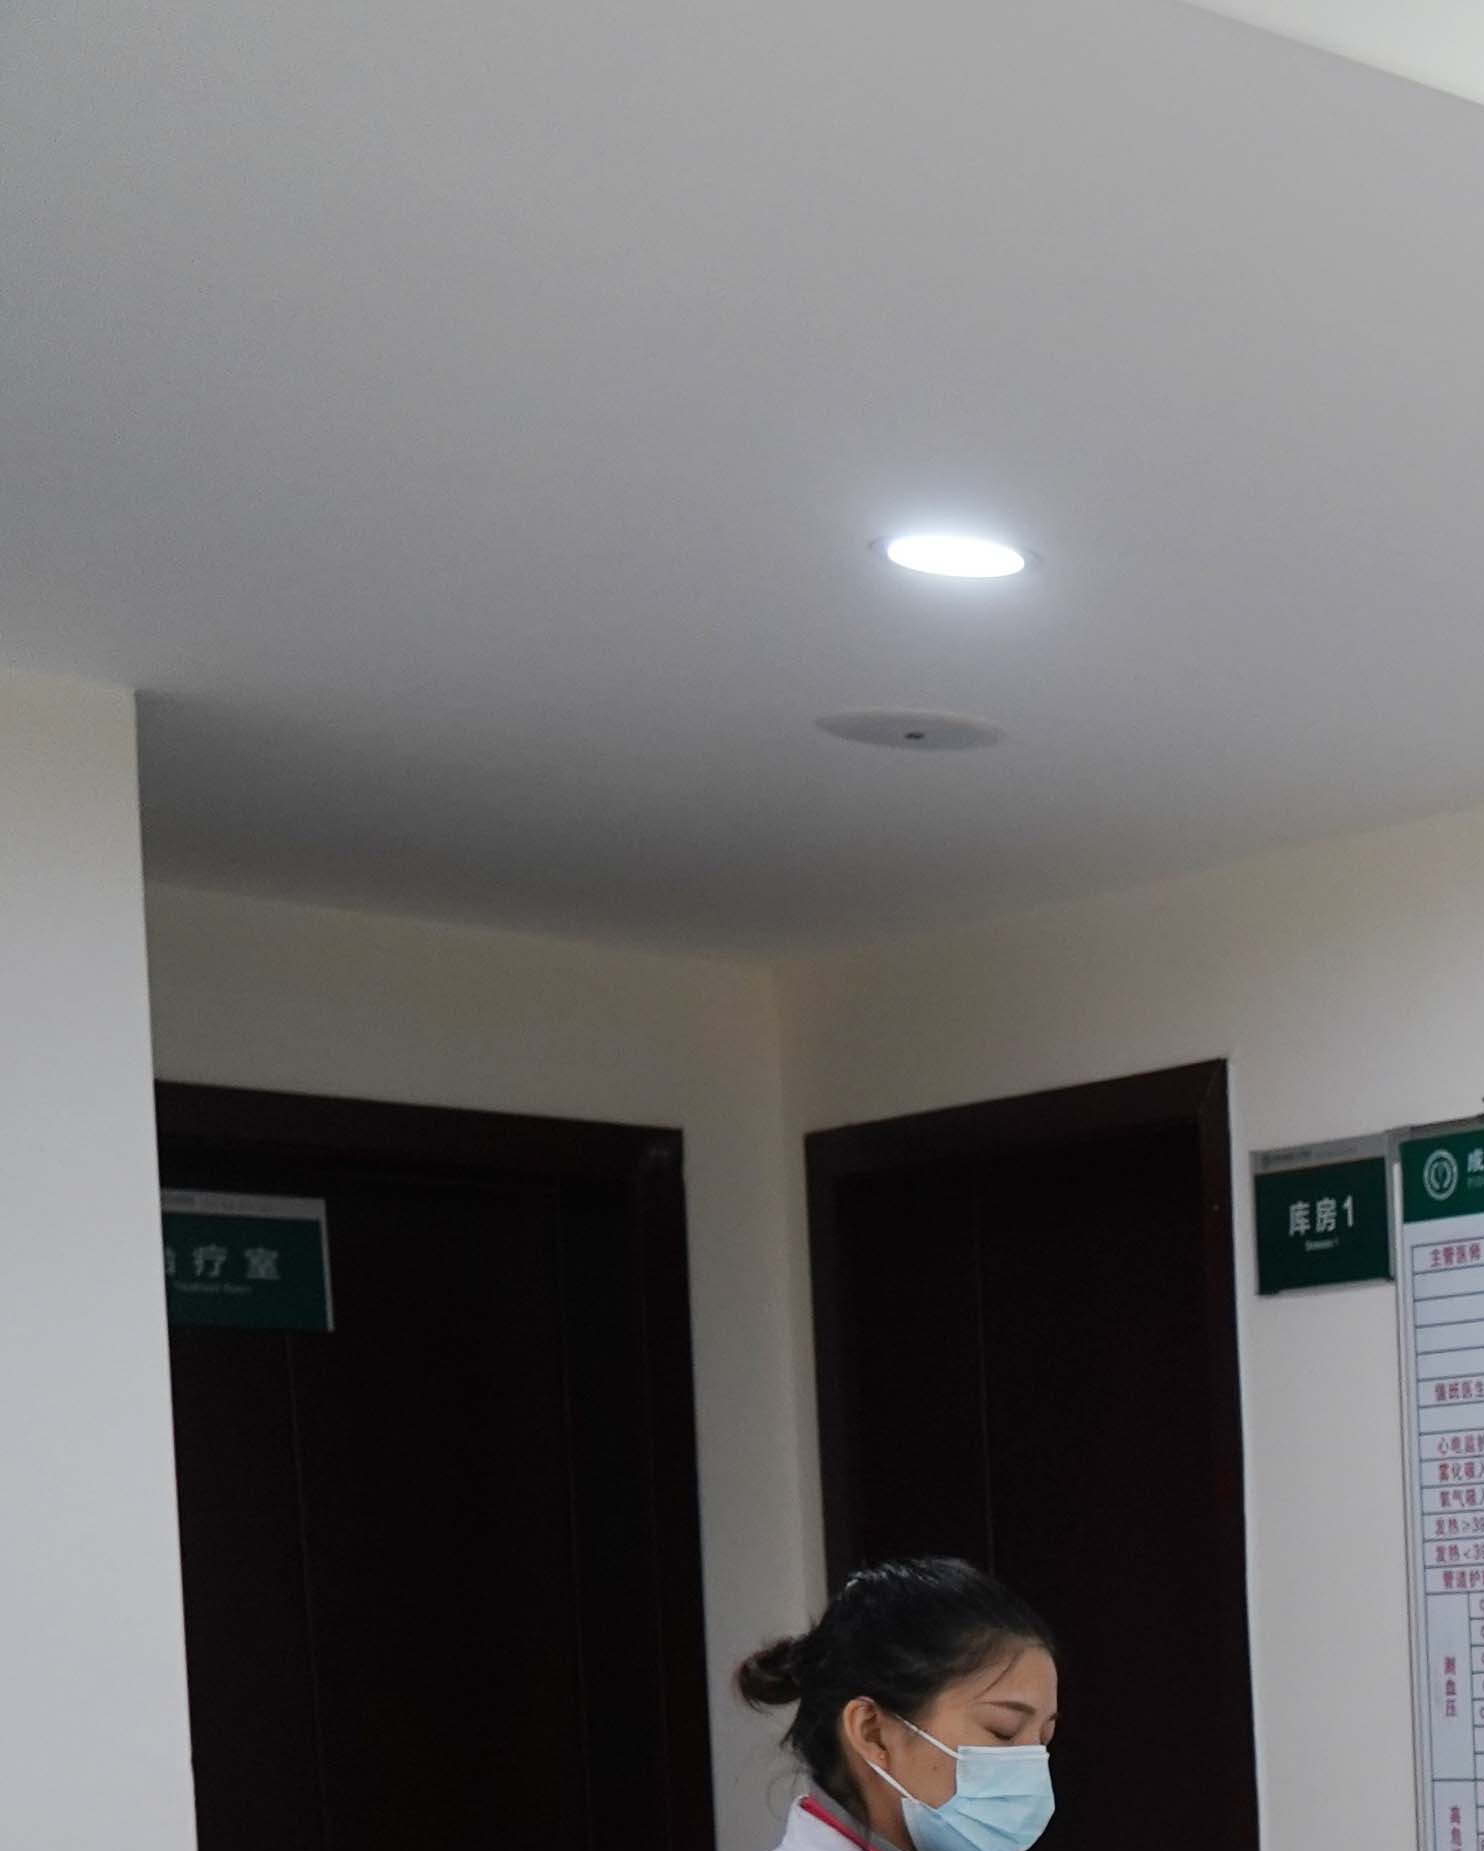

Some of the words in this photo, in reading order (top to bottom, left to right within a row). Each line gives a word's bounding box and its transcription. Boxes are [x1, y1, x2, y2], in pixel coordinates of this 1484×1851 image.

[1289, 1195, 1354, 1237] 库房1
[164, 1244, 280, 1280] 疗室
[1429, 1242, 1481, 1268] 主管医师
